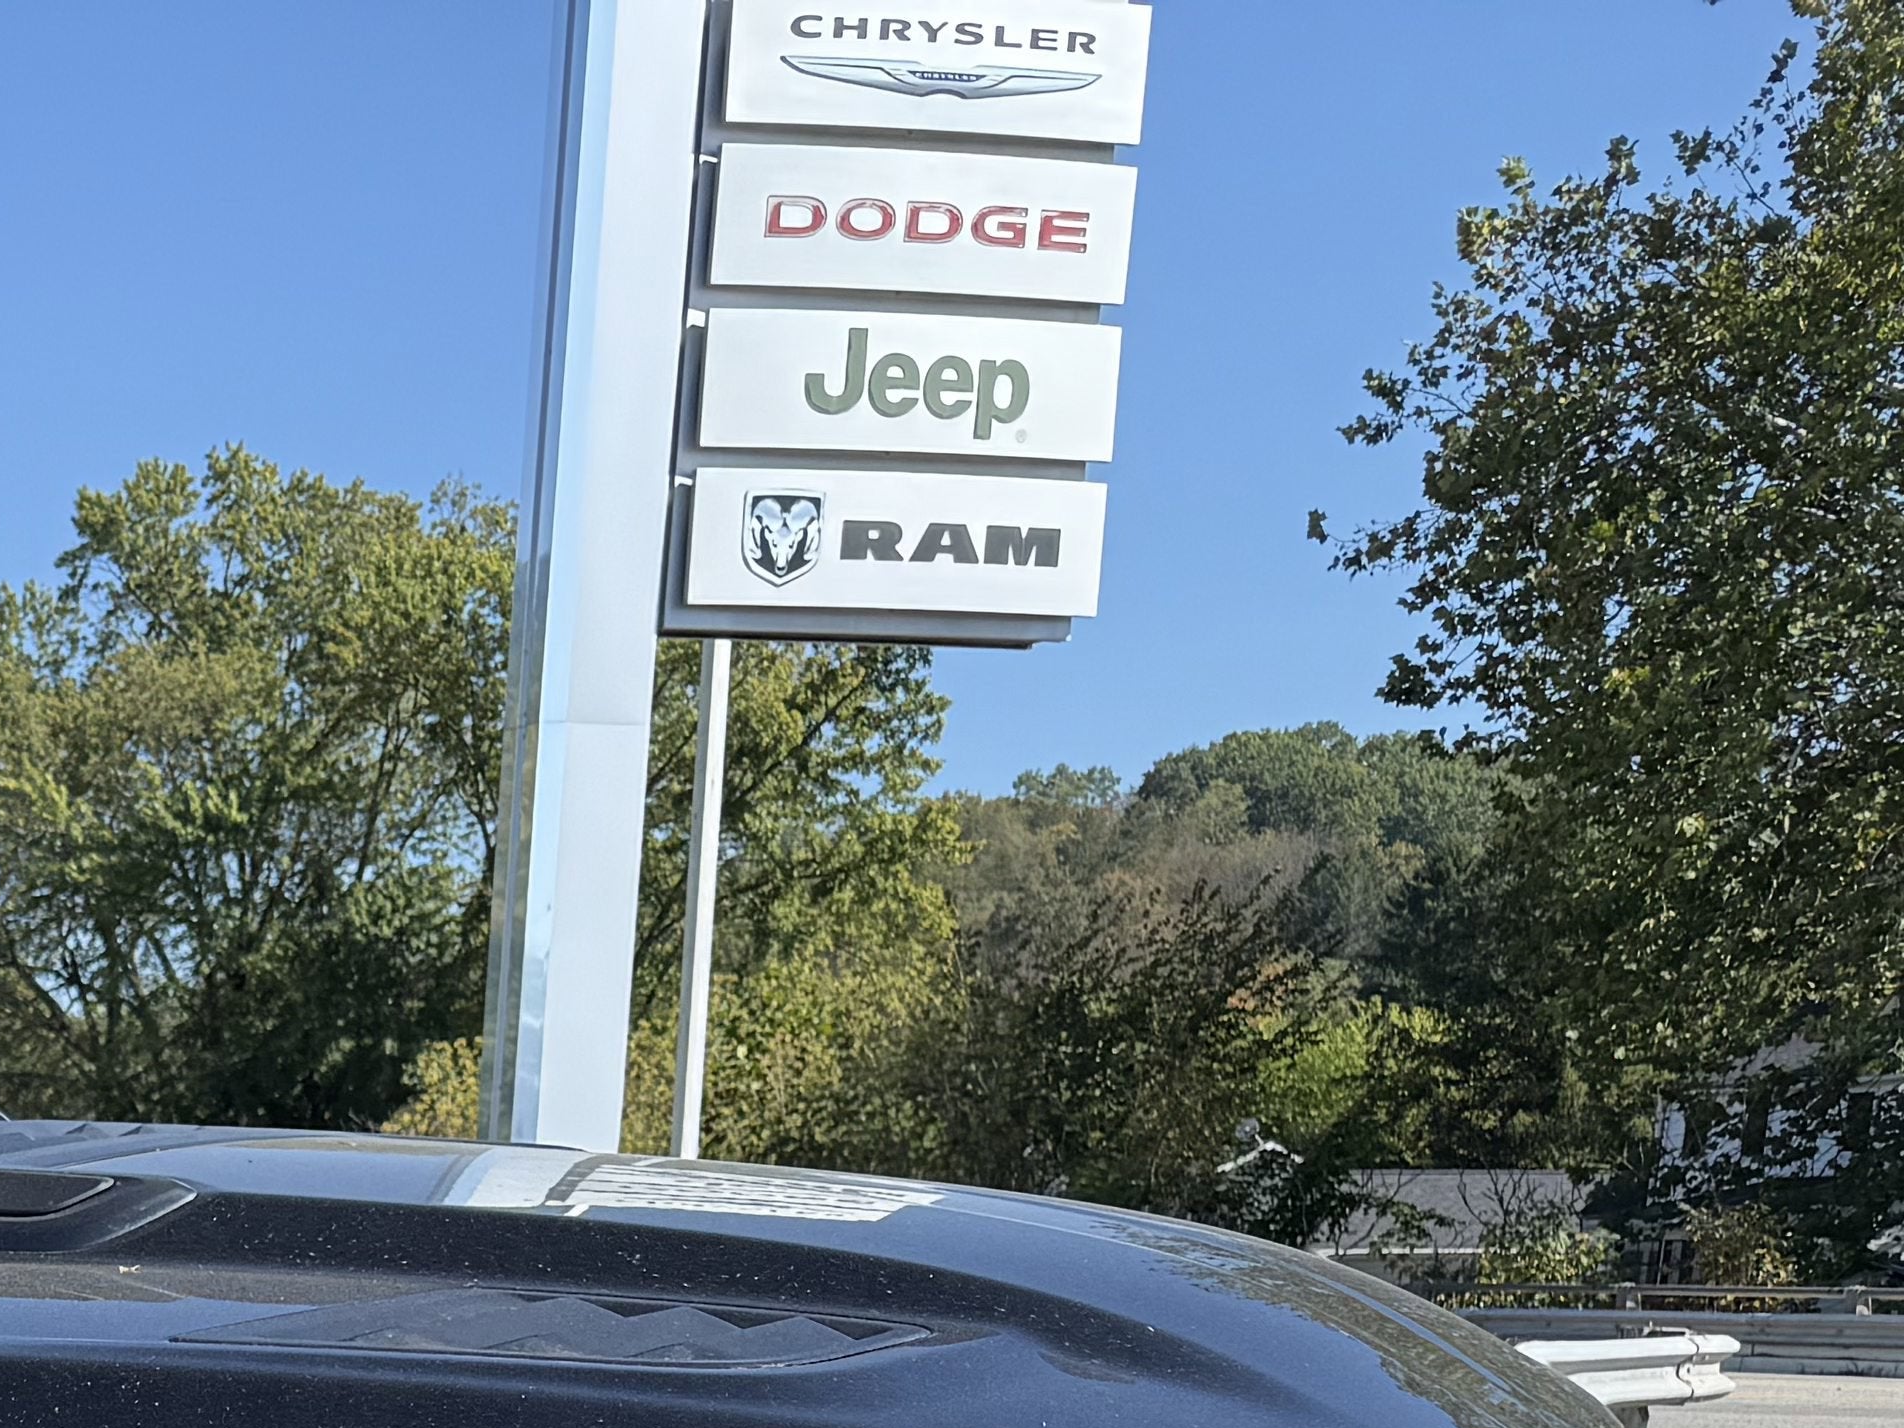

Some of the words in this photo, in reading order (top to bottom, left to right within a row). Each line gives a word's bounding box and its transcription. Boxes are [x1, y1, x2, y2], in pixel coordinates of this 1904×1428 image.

[789, 13, 1097, 55] CHRYSLER
[763, 194, 1091, 254] DODGE
[803, 327, 1031, 441] Jeep
[839, 519, 1062, 568] RAM
